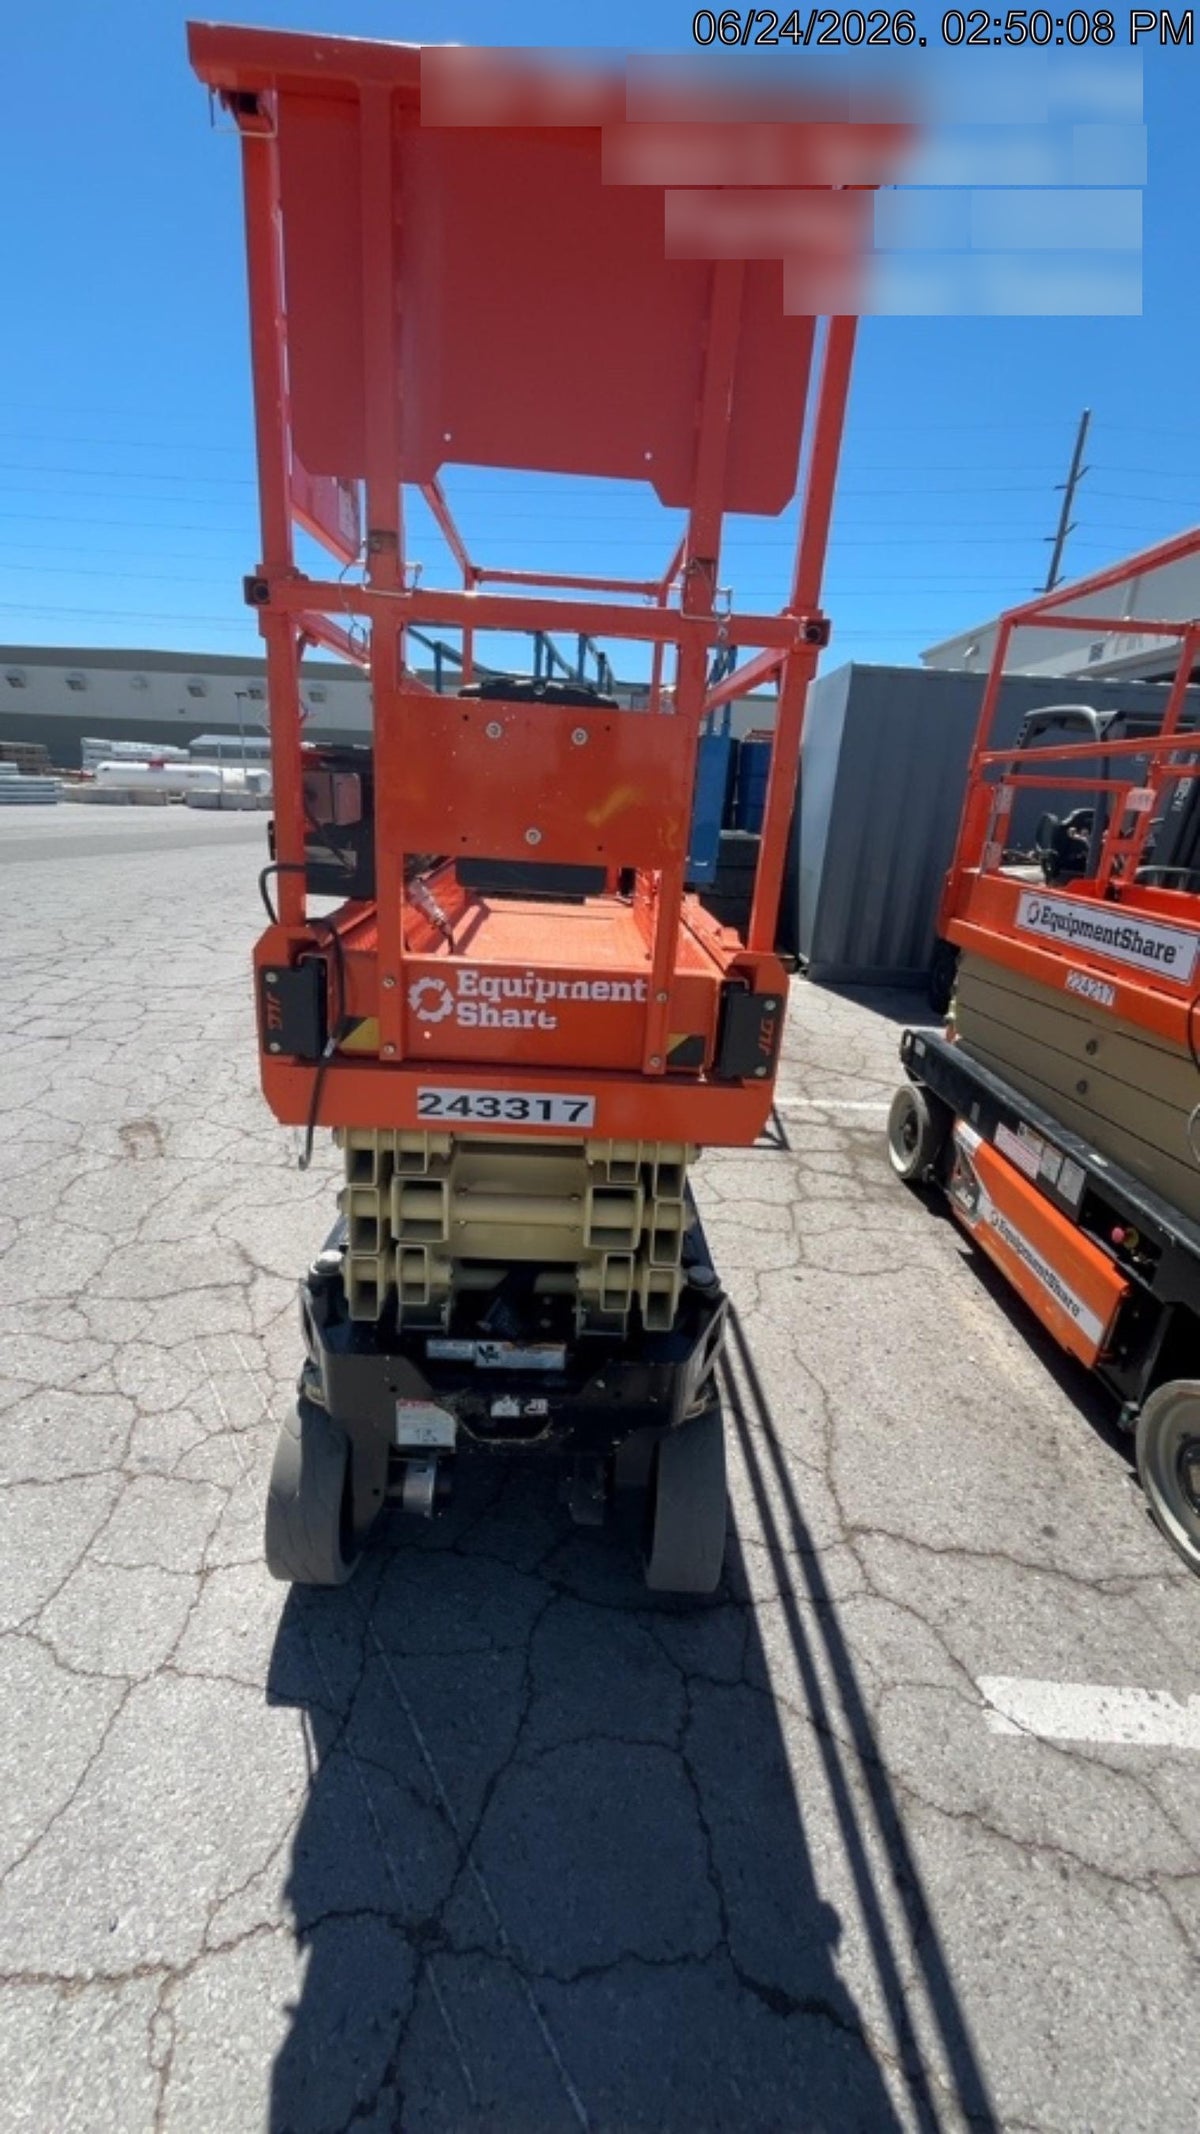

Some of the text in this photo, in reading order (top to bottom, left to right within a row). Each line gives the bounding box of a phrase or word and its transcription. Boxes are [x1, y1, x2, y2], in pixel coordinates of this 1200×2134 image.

[1041, 905, 1177, 964] EquipmentShare
[456, 969, 648, 1003] Equipment
[418, 1092, 589, 1122] 243317
